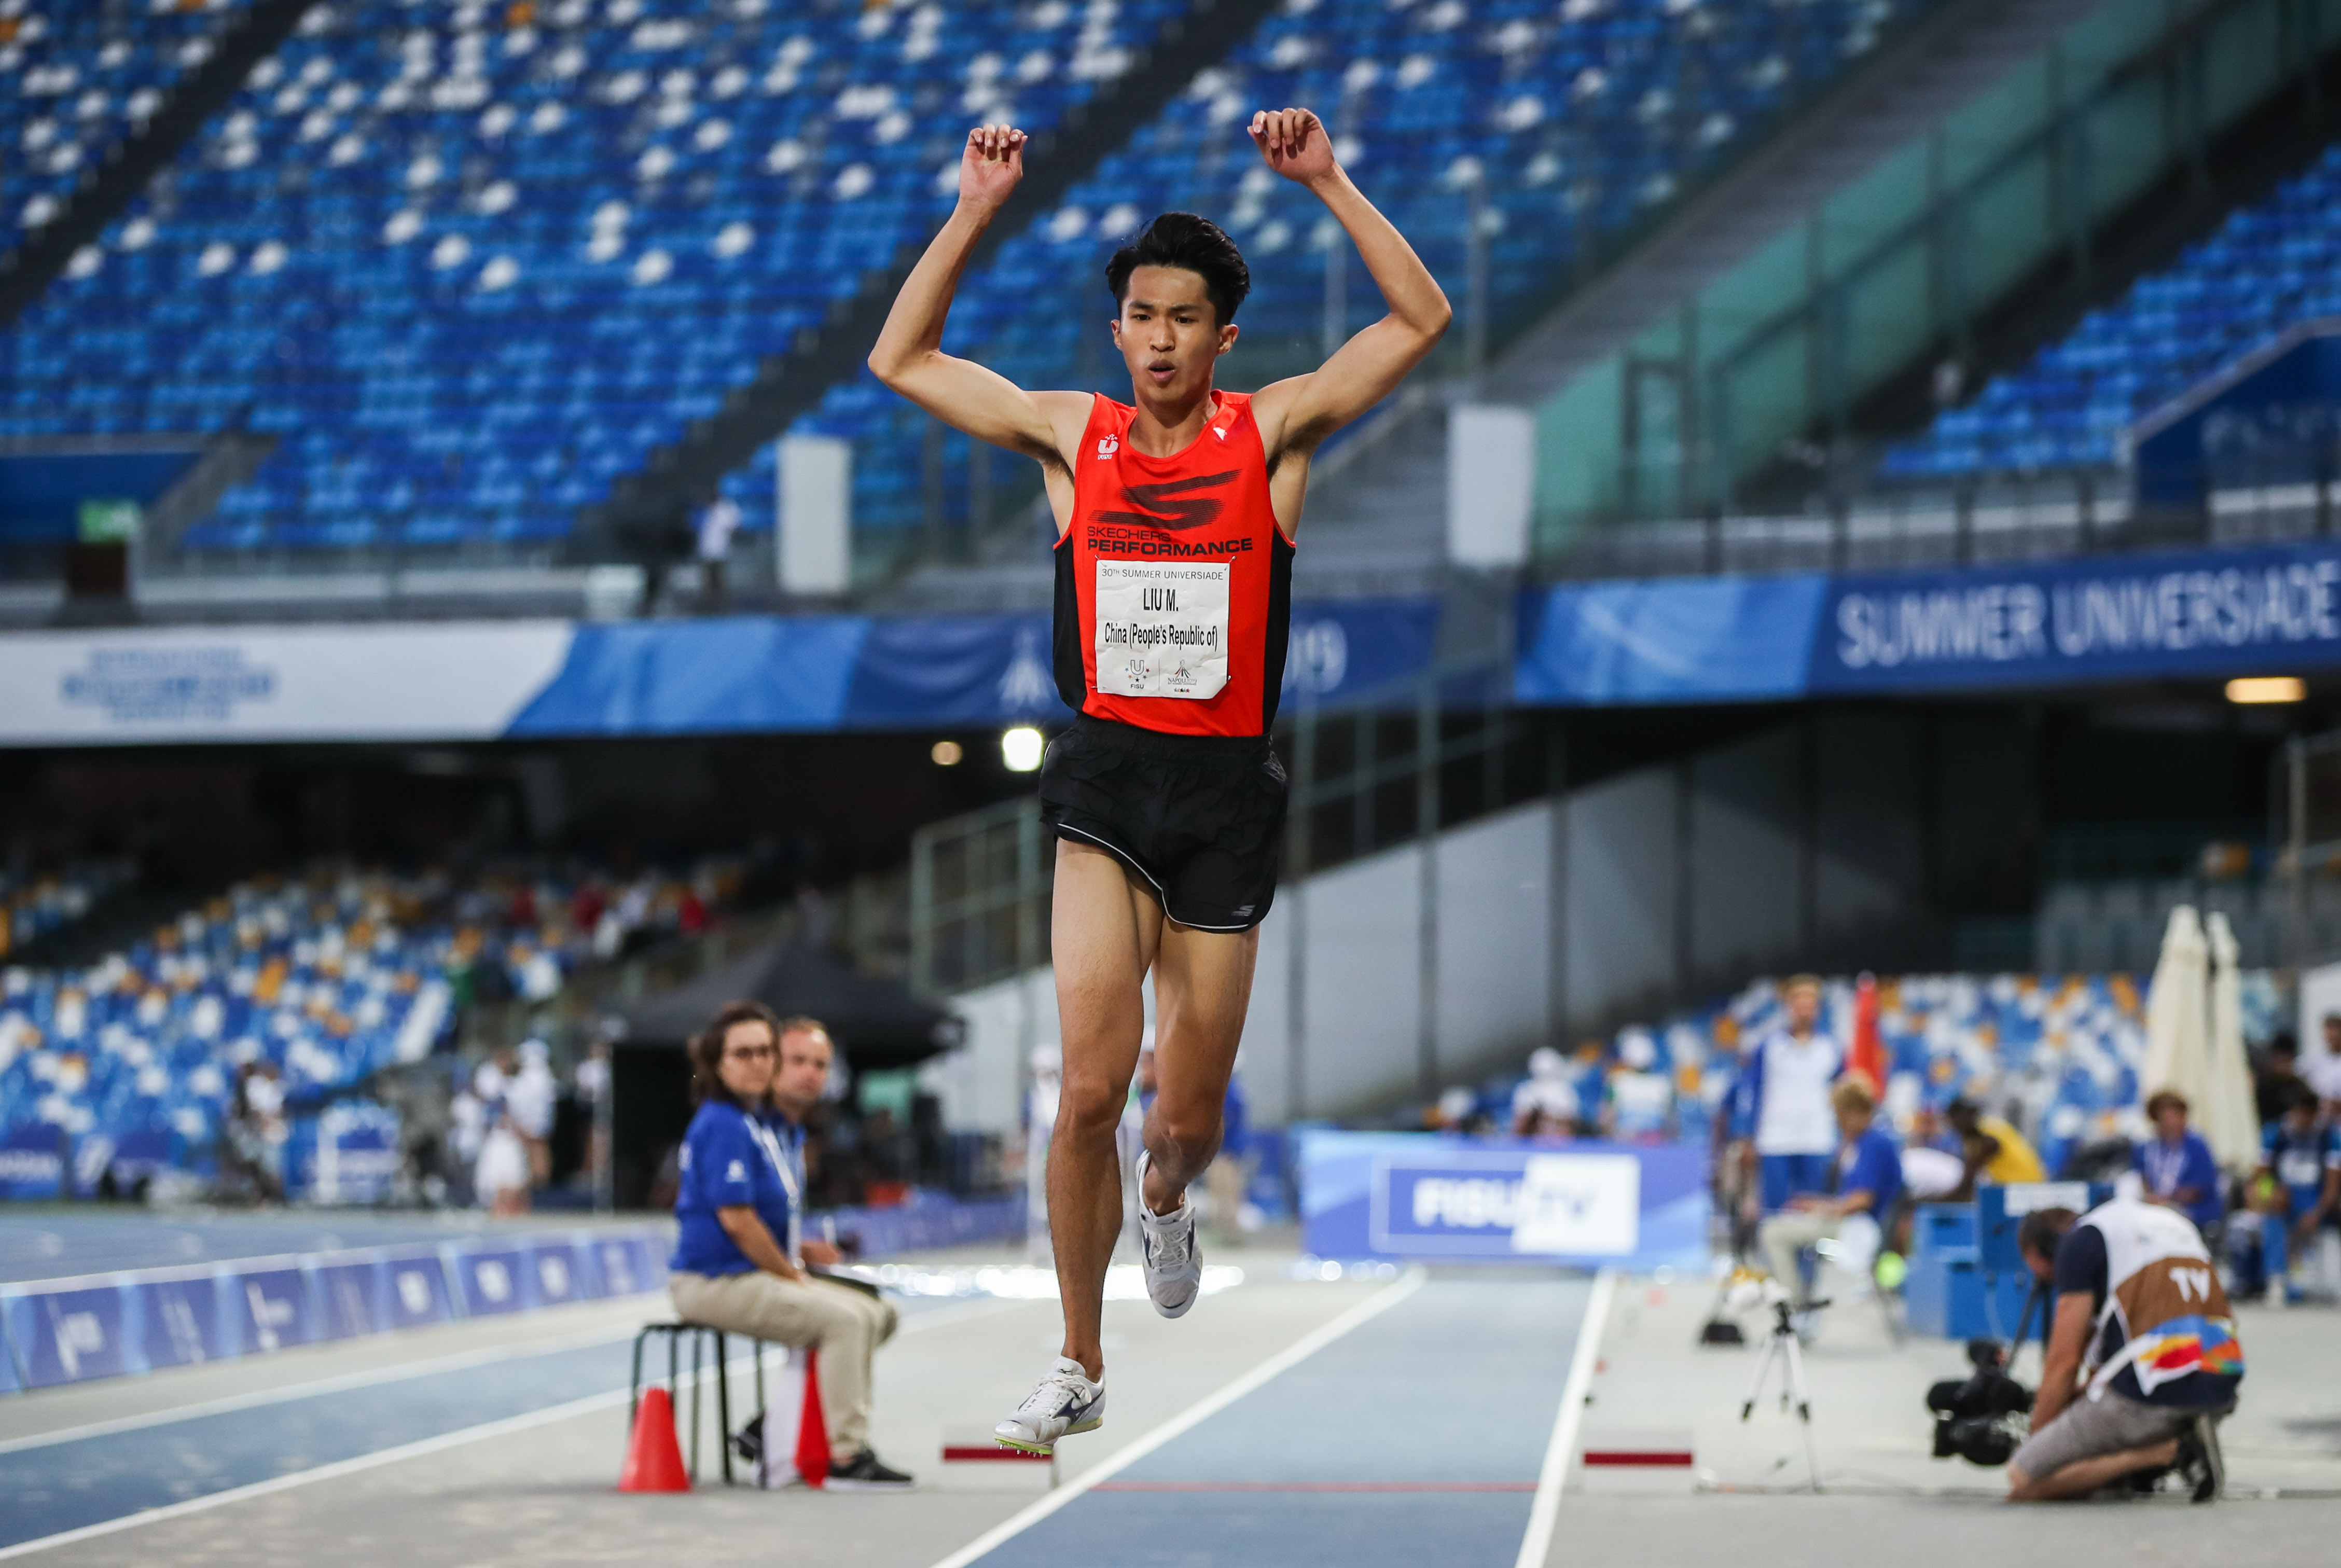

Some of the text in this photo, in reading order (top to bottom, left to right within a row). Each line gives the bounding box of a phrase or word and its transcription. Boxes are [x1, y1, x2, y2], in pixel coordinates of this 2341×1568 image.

[1087, 526, 1172, 542] SKECHERS
[1088, 538, 1253, 556] PERFORMANCE
[1102, 568, 1224, 580] 30TH SUMMER UNIVERSIADE
[1143, 588, 1179, 612] LIU M.
[1105, 622, 1218, 652] China (People's Republic of)
[1837, 583, 2047, 668] SUMMER
[2169, 1266, 2210, 1303] TV
